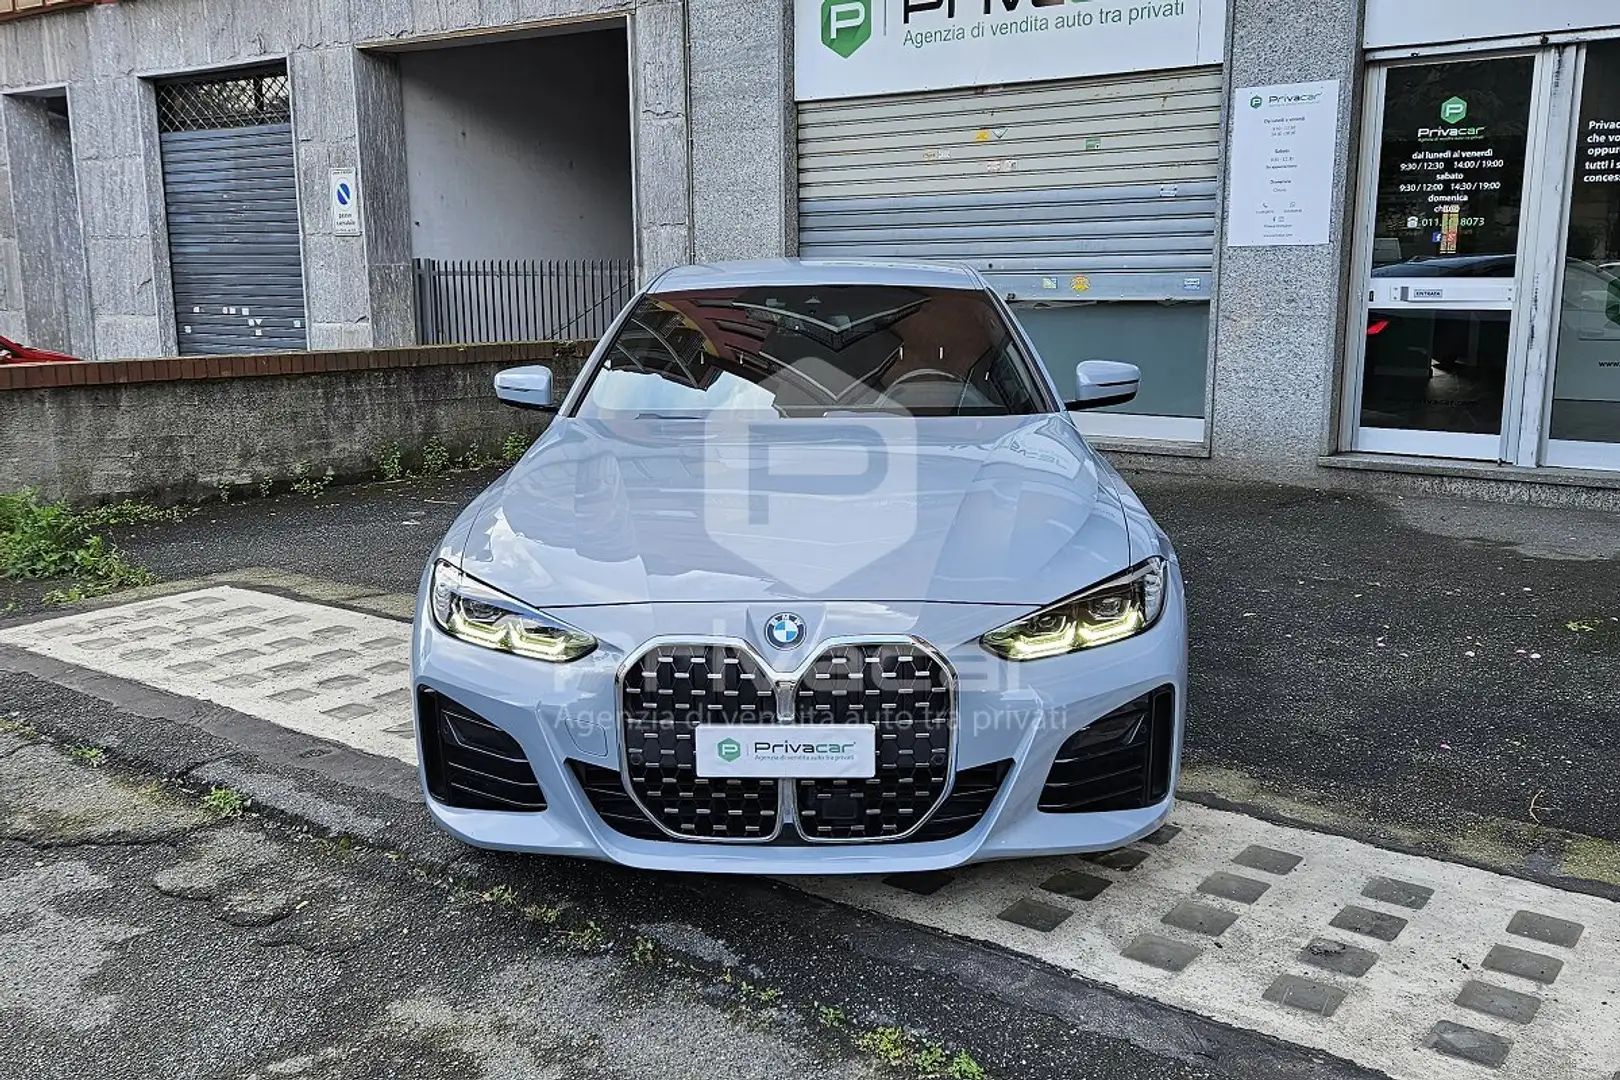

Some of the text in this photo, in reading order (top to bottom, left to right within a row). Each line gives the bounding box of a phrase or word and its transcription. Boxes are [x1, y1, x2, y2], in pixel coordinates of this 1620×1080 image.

[903, 25, 965, 48] Agenzia
[971, 22, 985, 39] di
[991, 15, 1049, 36] vendita
[1055, 12, 1093, 30] auto
[1099, 8, 1122, 25] tra
[1128, 1, 1184, 25] privati
[1268, 93, 1321, 103] Privacar
[1417, 125, 1484, 137] Privacar
[1586, 133, 1605, 142] che
[1412, 151, 1425, 160] dal
[1452, 149, 1460, 158] al
[1400, 162, 1417, 171] 9:30
[1424, 161, 1444, 170] 12:30
[1454, 160, 1475, 169] 14:00
[1482, 159, 1504, 168] 19:00
[1584, 160, 1608, 170] tutti
[1436, 172, 1464, 180] sabato
[1399, 183, 1416, 192] 9:30
[1422, 183, 1443, 191] 12:00
[1451, 182, 1472, 190] 14:30
[1479, 181, 1501, 190] 19:00
[1428, 193, 1468, 202] domenica
[755, 740, 855, 753] Privacar
